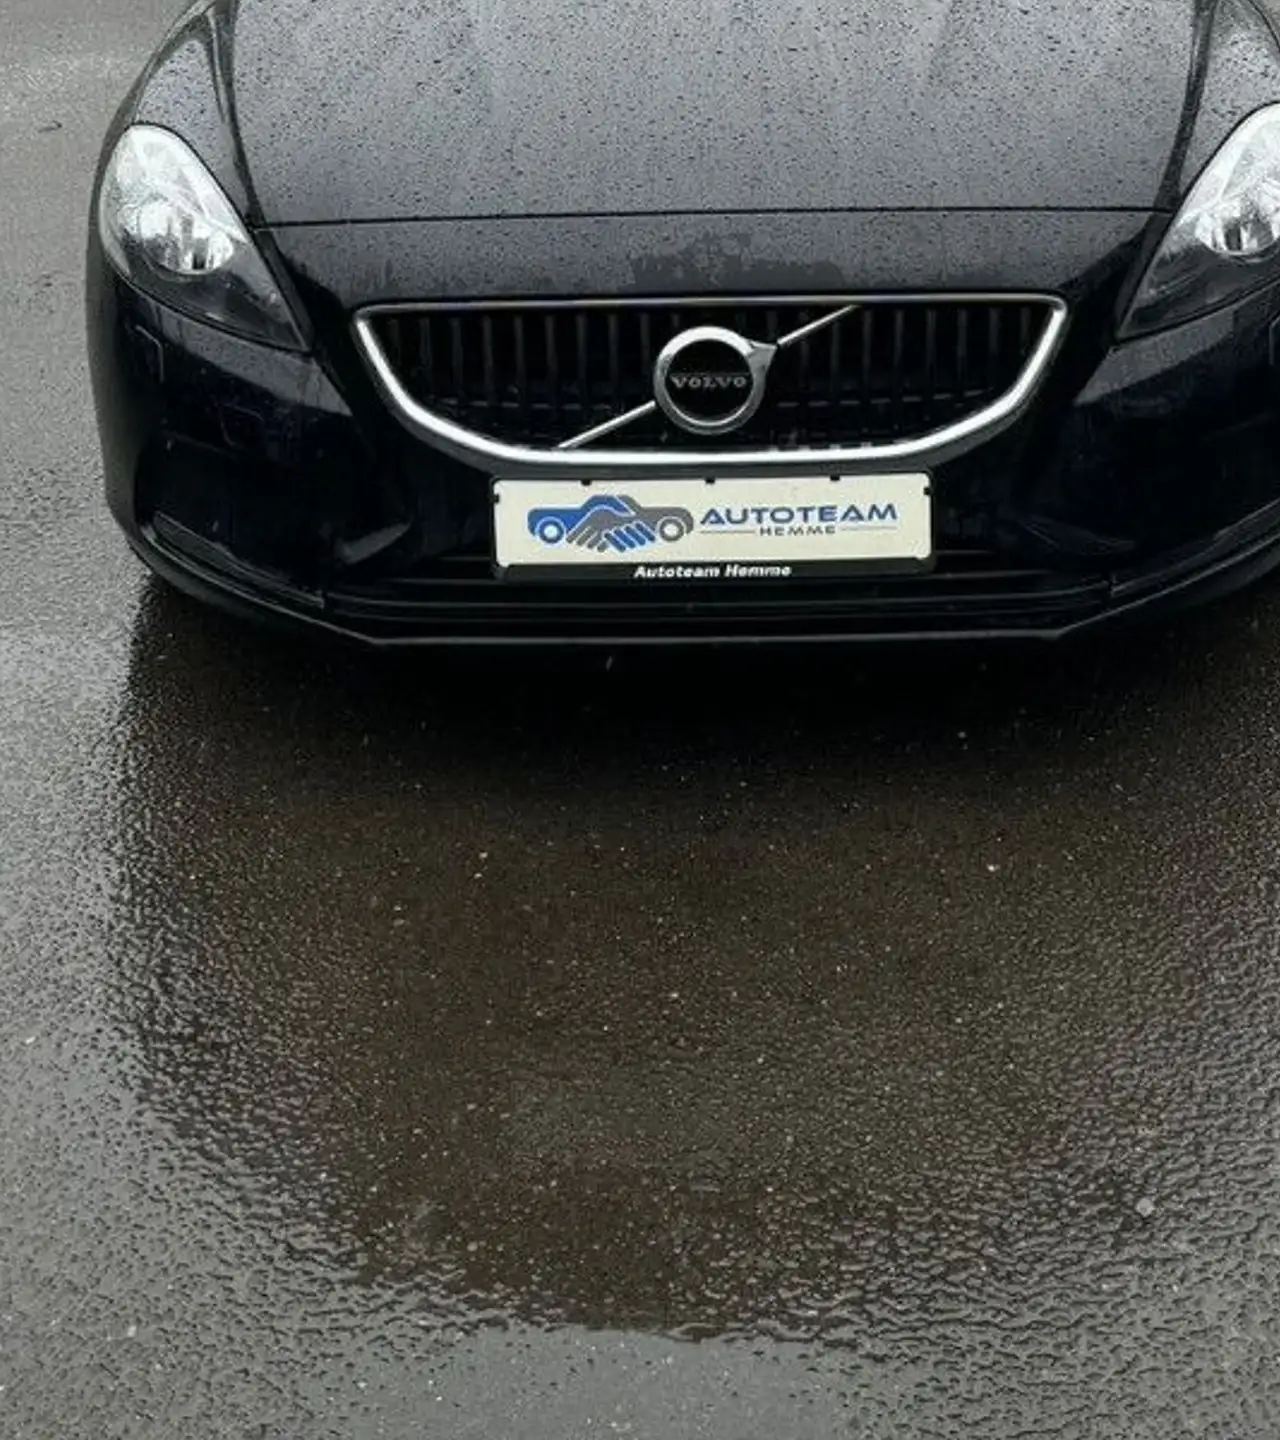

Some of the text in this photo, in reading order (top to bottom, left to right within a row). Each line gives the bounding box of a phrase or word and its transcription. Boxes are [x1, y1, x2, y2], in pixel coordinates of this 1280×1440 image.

[671, 376, 747, 389] VOLVO
[700, 503, 898, 525] AUTOTEAM
[759, 525, 837, 537] HEMME
[633, 563, 793, 578] Autoteam Hemme
